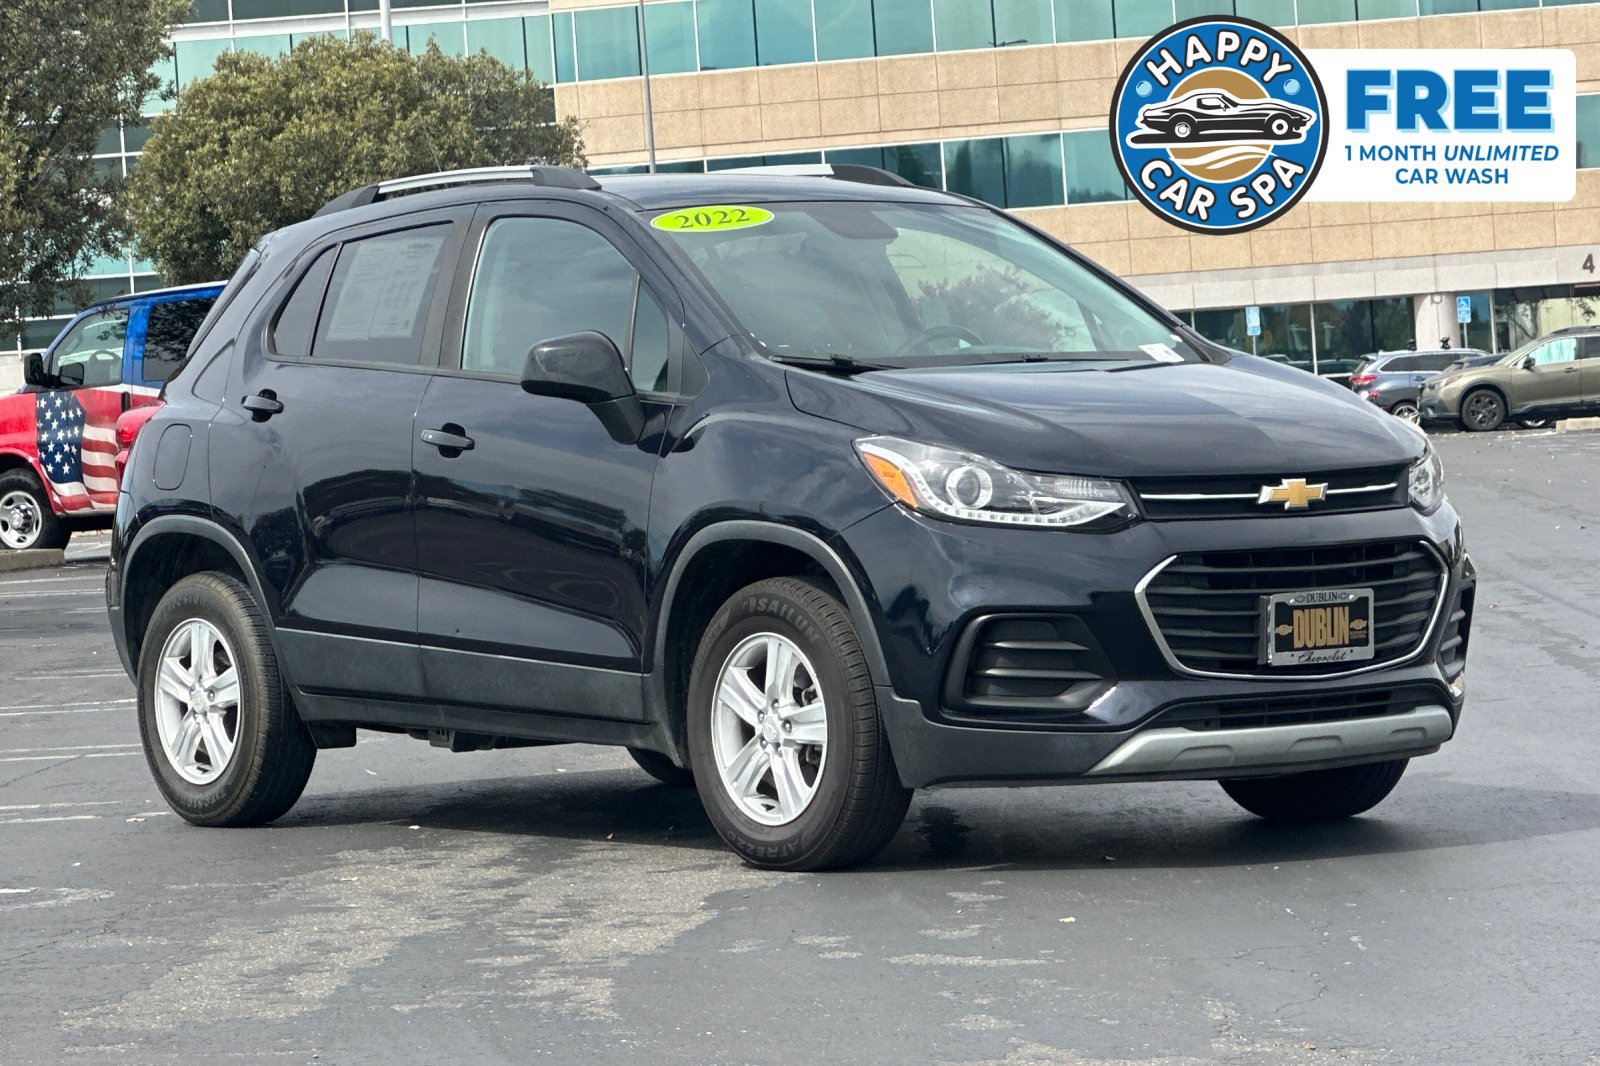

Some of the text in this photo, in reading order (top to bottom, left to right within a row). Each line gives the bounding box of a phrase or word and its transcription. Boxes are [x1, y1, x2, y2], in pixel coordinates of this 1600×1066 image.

[675, 208, 750, 229] 2022
[1582, 253, 1596, 273] 4
[1306, 592, 1338, 603] DUBLIN
[1293, 606, 1349, 648] DUBLIN
[1298, 650, 1347, 664] Chevrolet
